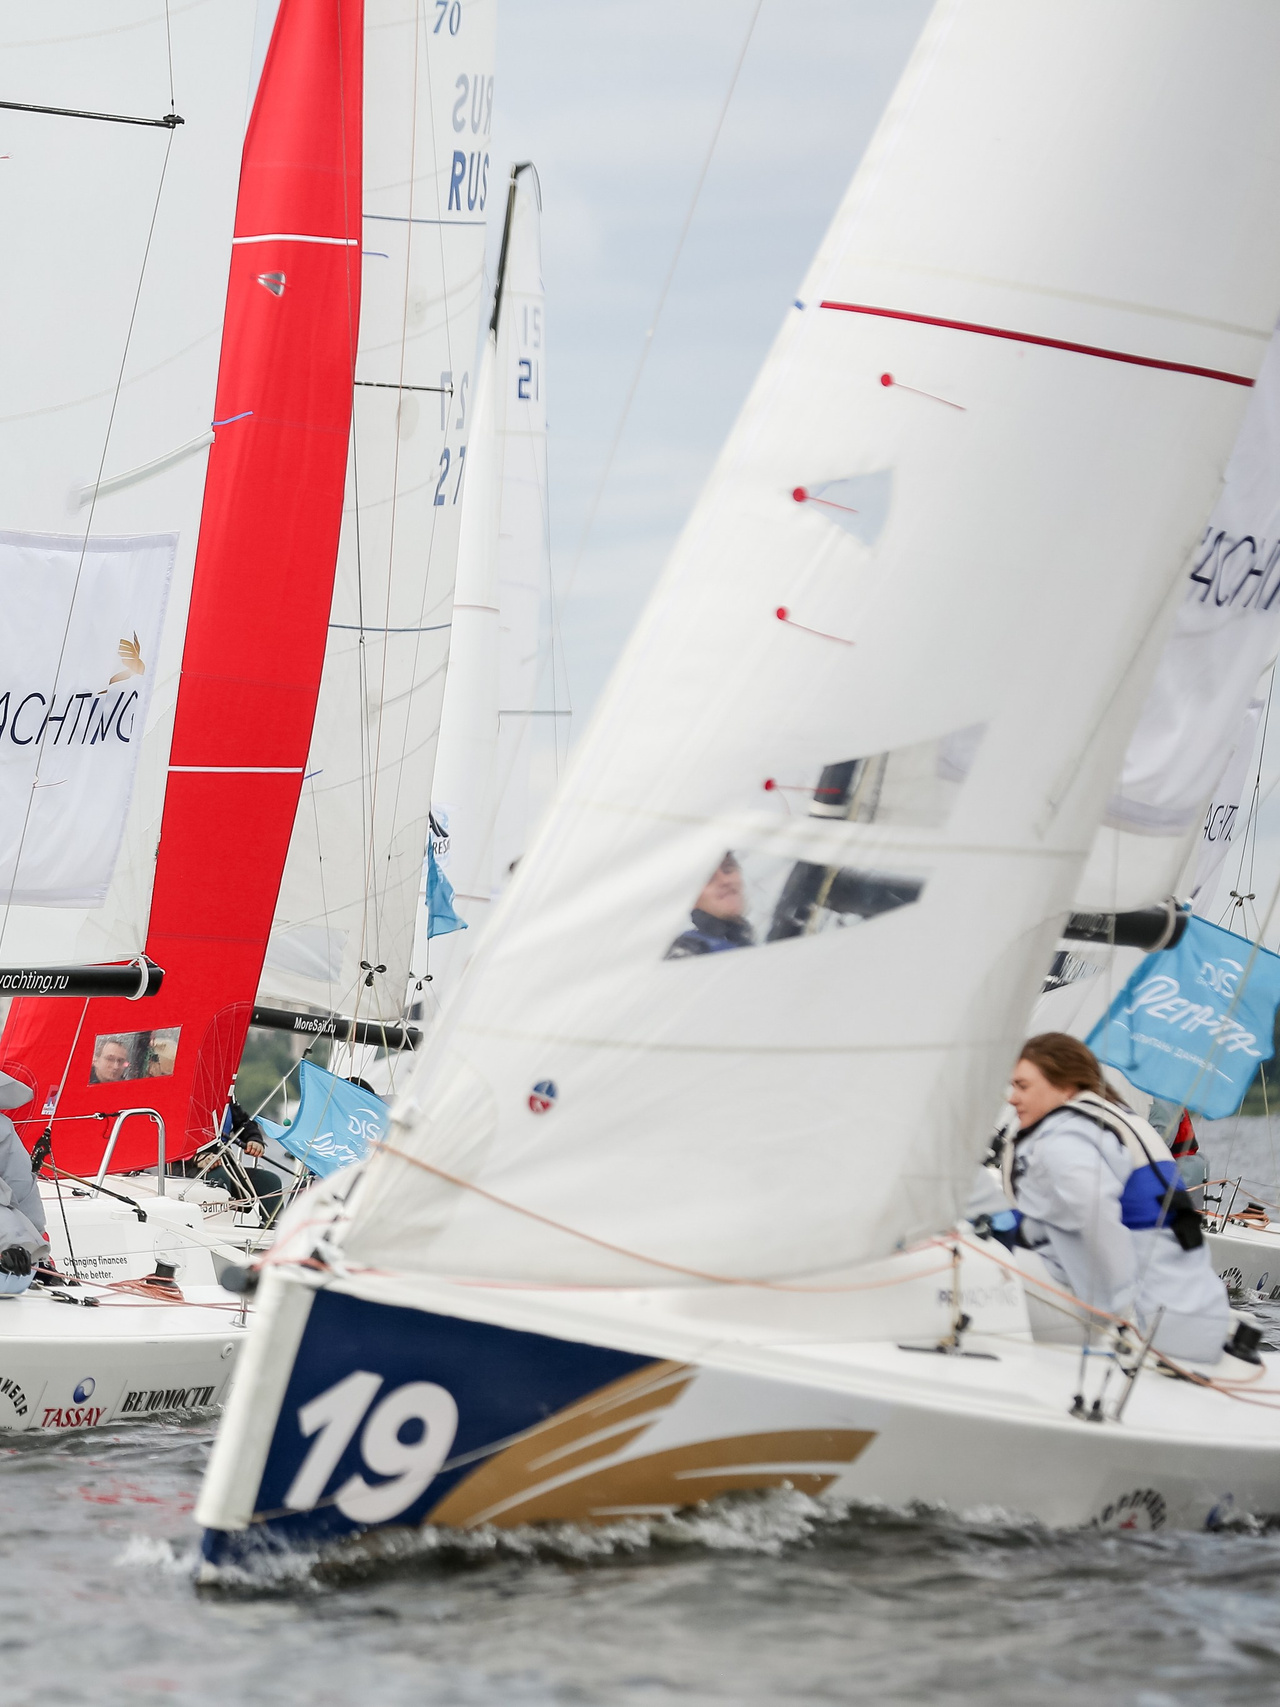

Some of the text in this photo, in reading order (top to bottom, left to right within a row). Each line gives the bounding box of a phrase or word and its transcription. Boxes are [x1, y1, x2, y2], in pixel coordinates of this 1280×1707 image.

[433, 1, 462, 36] 70
[448, 151, 490, 212] RUS
[518, 359, 540, 402] 21
[433, 446, 466, 506] 27
[347, 1114, 381, 1141] DIS
[63, 1255, 128, 1268] Changing finances
[90, 1270, 114, 1280] better.
[40, 1407, 107, 1428] TASSAY
[283, 1370, 459, 1524] 19
